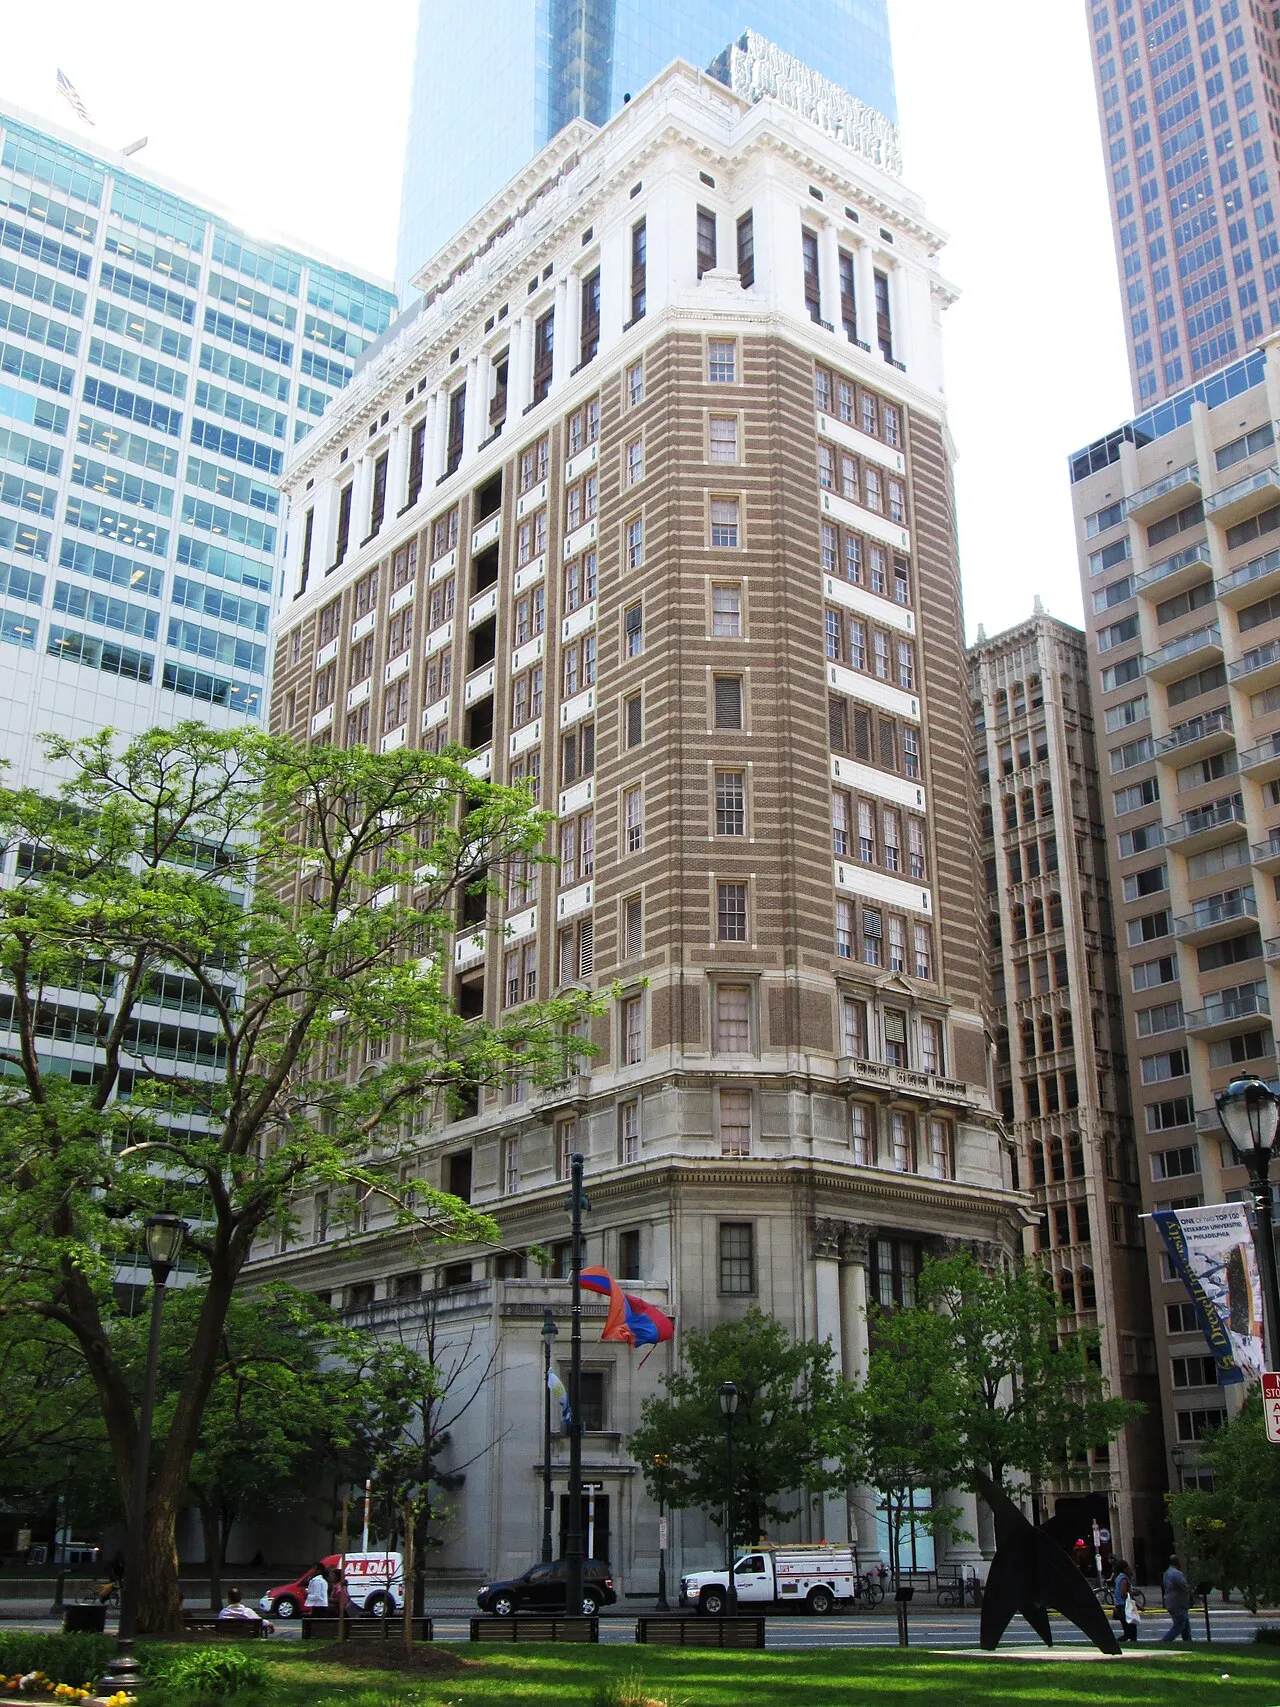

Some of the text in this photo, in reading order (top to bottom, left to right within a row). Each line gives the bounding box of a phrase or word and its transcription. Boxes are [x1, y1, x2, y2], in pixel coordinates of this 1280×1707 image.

[1215, 1213, 1228, 1221] TOP
[1228, 1212, 1240, 1220] 100
[1183, 1225, 1210, 1233] RESEARCH
[1194, 1231, 1230, 1240] PHILADELPHIA
[1196, 1296, 1227, 1347] Drexel
[344, 1562, 364, 1575] AL
